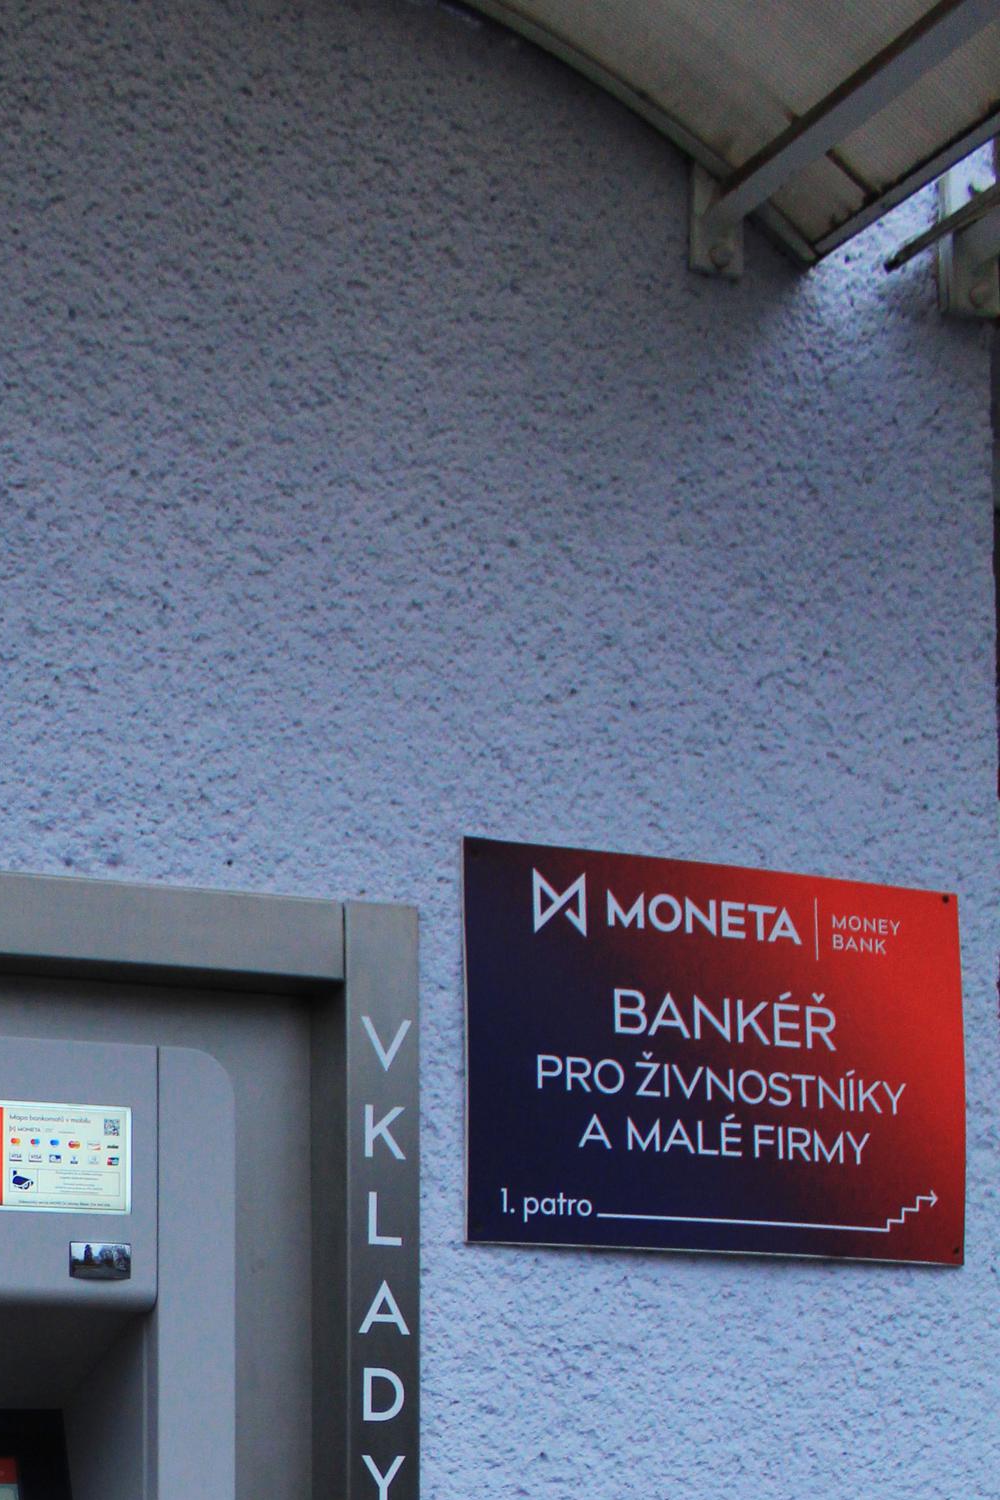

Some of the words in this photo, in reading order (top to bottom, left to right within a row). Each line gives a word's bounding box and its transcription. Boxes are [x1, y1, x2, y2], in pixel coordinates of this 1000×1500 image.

[607, 888, 802, 945] MONETA
[832, 914, 901, 936] MONEY
[832, 934, 887, 954] BANK
[613, 988, 837, 1051] BANKÉŘ
[536, 1054, 624, 1094] PRO
[635, 1051, 906, 1115] ŽIVNOSTNÍKY
[578, 1113, 612, 1150] A
[626, 1114, 743, 1157] MALÉ
[754, 1125, 870, 1165] FIRMY
[500, 1188, 516, 1214] 1.
[523, 1192, 593, 1222] patro
